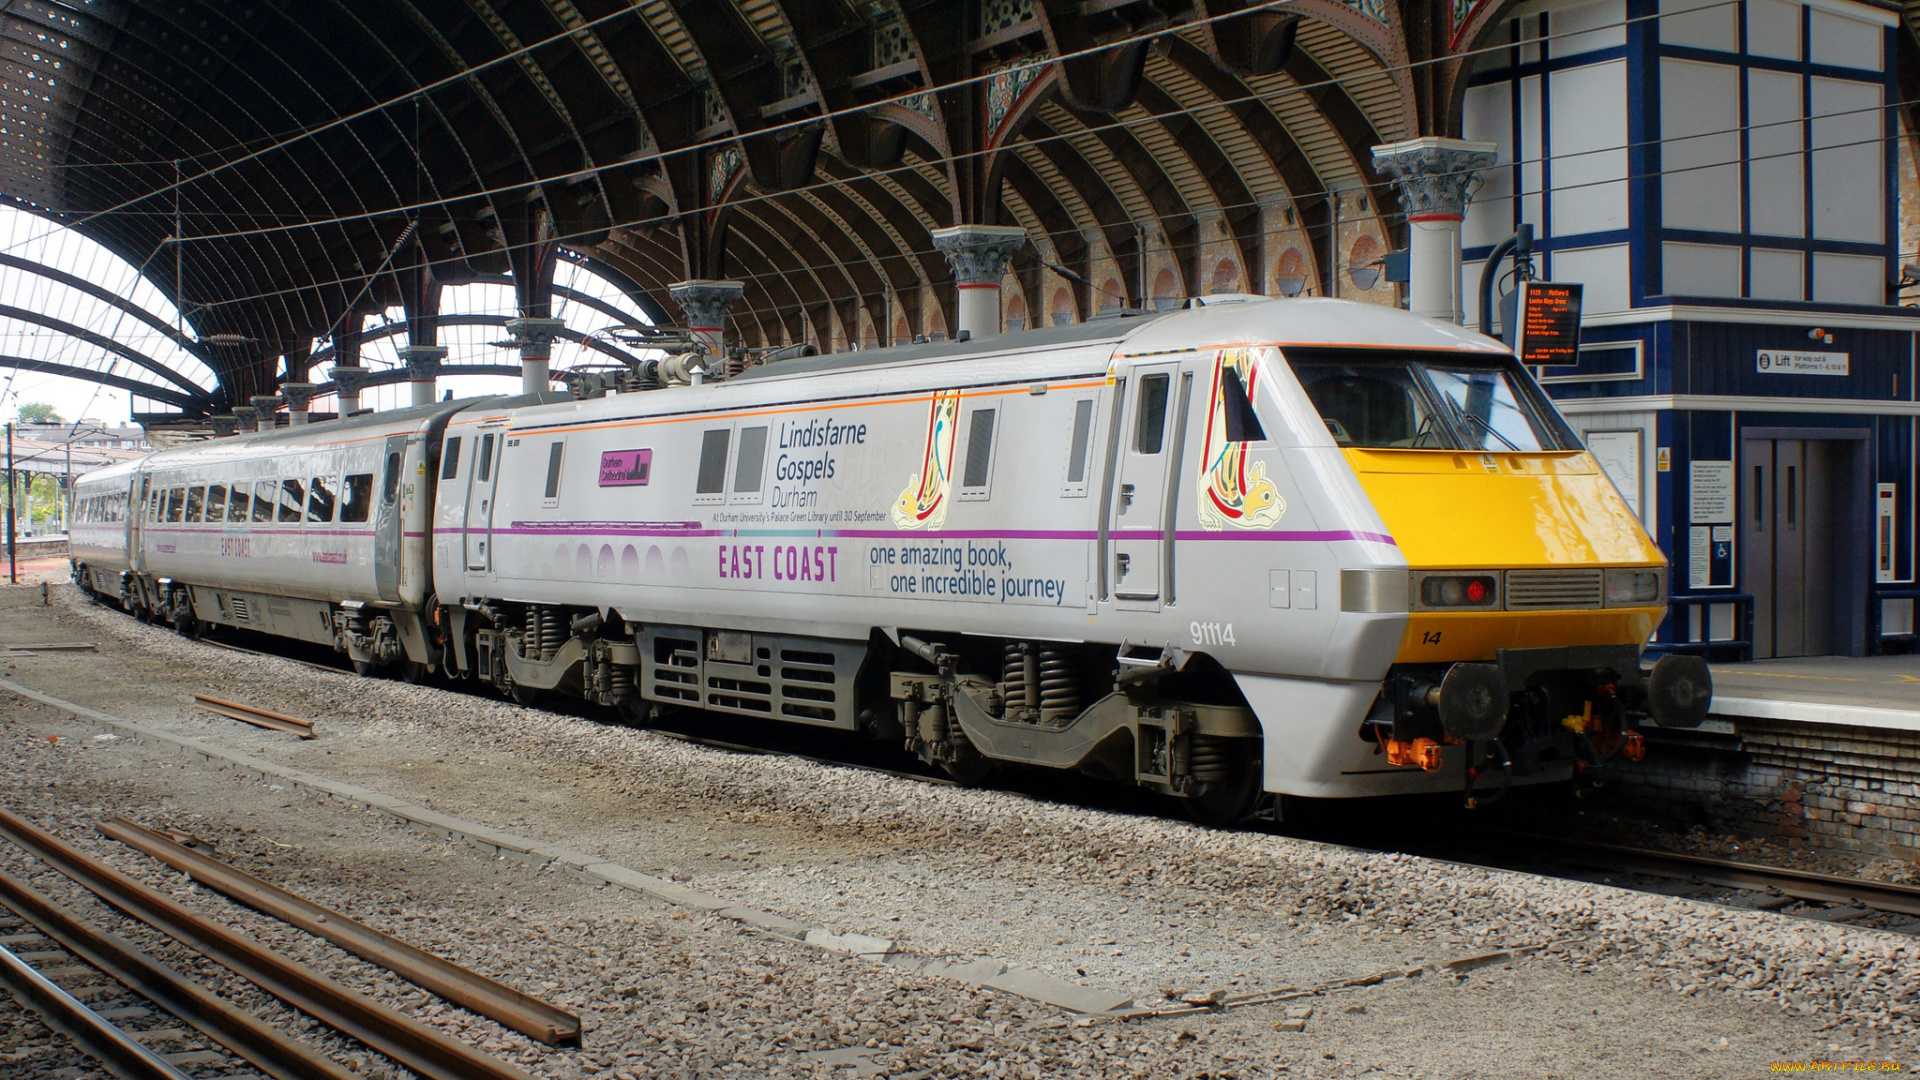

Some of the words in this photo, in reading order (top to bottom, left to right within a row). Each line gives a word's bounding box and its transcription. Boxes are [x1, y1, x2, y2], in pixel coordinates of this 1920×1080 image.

[1775, 355, 1790, 366] Lift
[779, 418, 866, 448] Lindisfarne
[602, 457, 623, 468] Durham
[776, 451, 835, 486] Gospels
[601, 469, 626, 481] Cathedral
[772, 484, 817, 508] Durham
[712, 512, 719, 522] At
[720, 512, 739, 522] Durham
[740, 512, 770, 524] University's
[771, 512, 789, 522] Palace
[790, 512, 807, 522] Green
[808, 511, 828, 524] Library
[829, 511, 842, 522] until
[844, 511, 852, 522] 30
[854, 510, 886, 524] September
[222, 538, 233, 556] EAST
[235, 538, 250, 558] COAST
[870, 546, 896, 564] one
[900, 540, 962, 572] amazing
[968, 540, 1012, 571] book,
[719, 545, 764, 580] EAST
[774, 545, 837, 582] COAST
[890, 574, 916, 593] one
[921, 568, 996, 596] incredible
[1000, 570, 1065, 606] journey
[1190, 621, 1236, 647] 91114
[1422, 631, 1442, 645] 14
